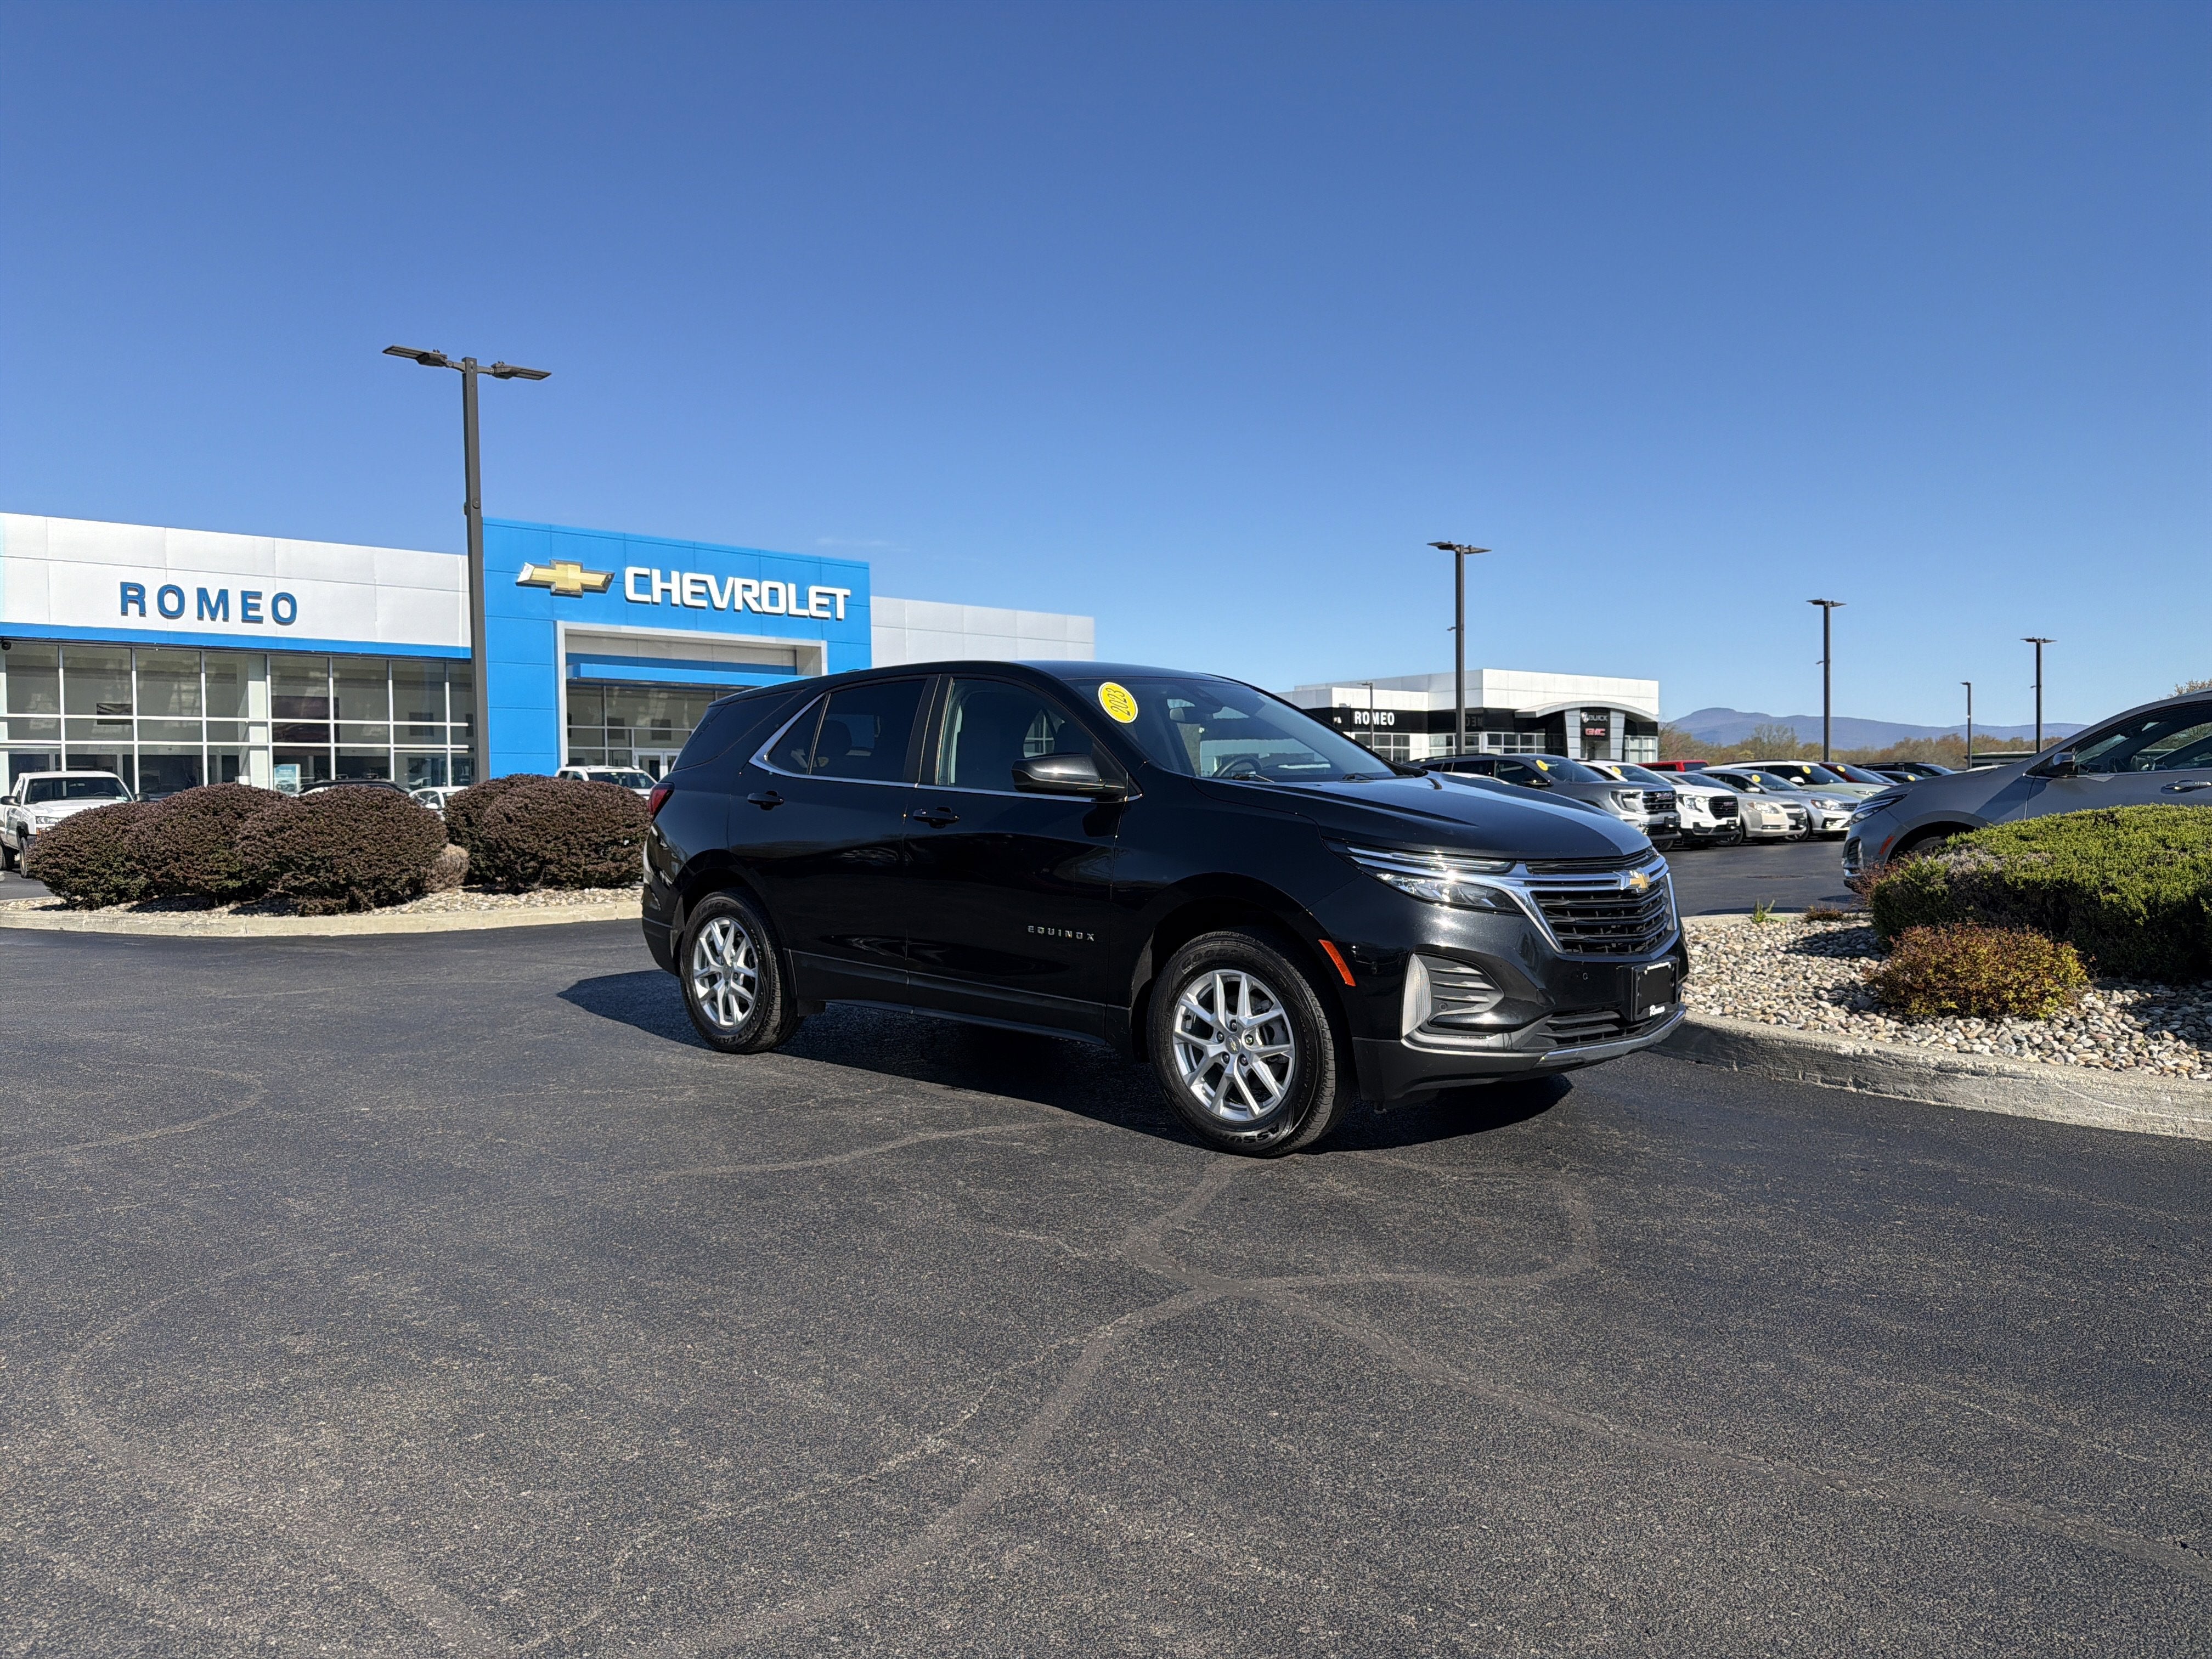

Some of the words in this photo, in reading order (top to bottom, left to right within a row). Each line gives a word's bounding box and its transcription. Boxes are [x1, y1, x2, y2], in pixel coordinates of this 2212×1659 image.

[120, 582, 297, 626] ROMEO
[625, 566, 851, 620] CHEVROLET
[1105, 687, 1131, 717] 2023
[1354, 711, 1395, 726] ROMEO
[1585, 727, 1606, 736] GMC
[1028, 926, 1094, 941] EQUINOX
